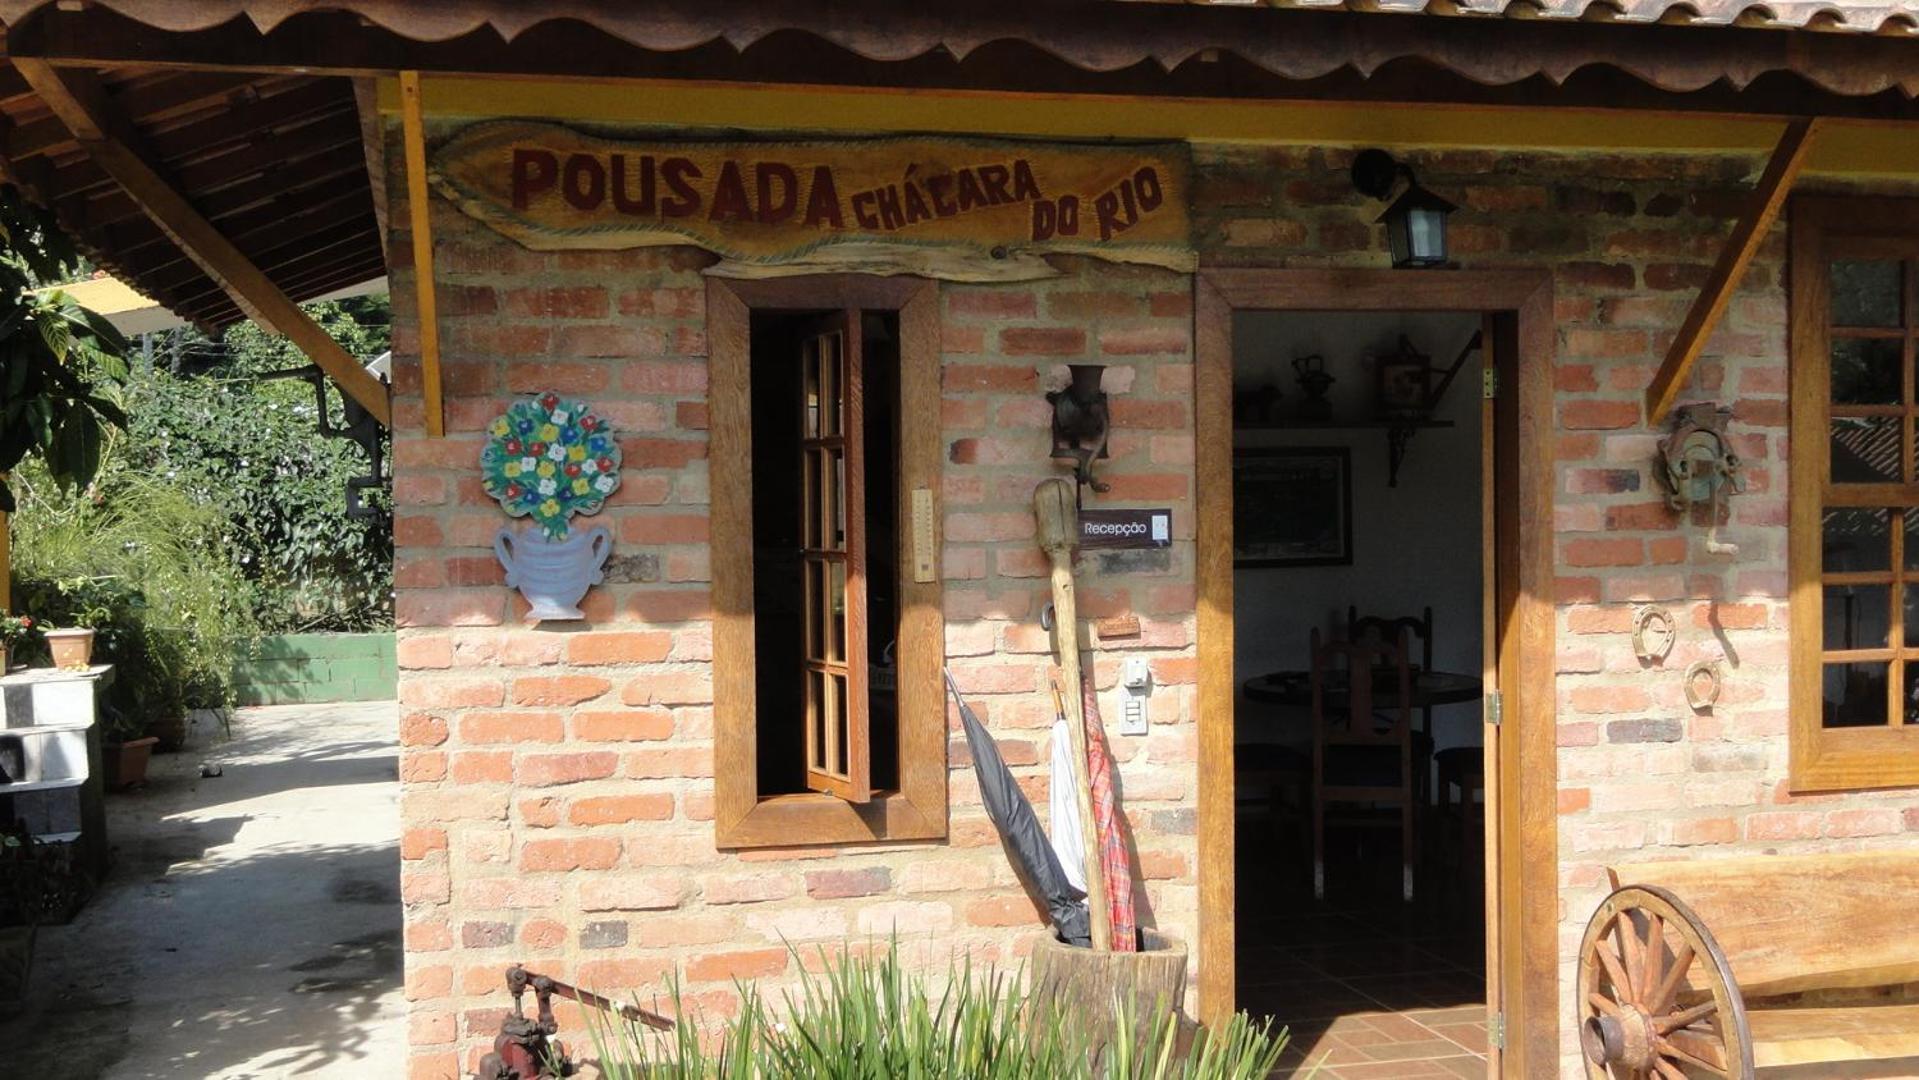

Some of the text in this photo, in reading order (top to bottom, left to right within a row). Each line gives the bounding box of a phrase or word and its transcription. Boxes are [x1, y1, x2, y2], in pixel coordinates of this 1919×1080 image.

[512, 149, 1163, 242] POUSADA CHÁCARA DO RIO
[1084, 521, 1147, 537] Recepção
